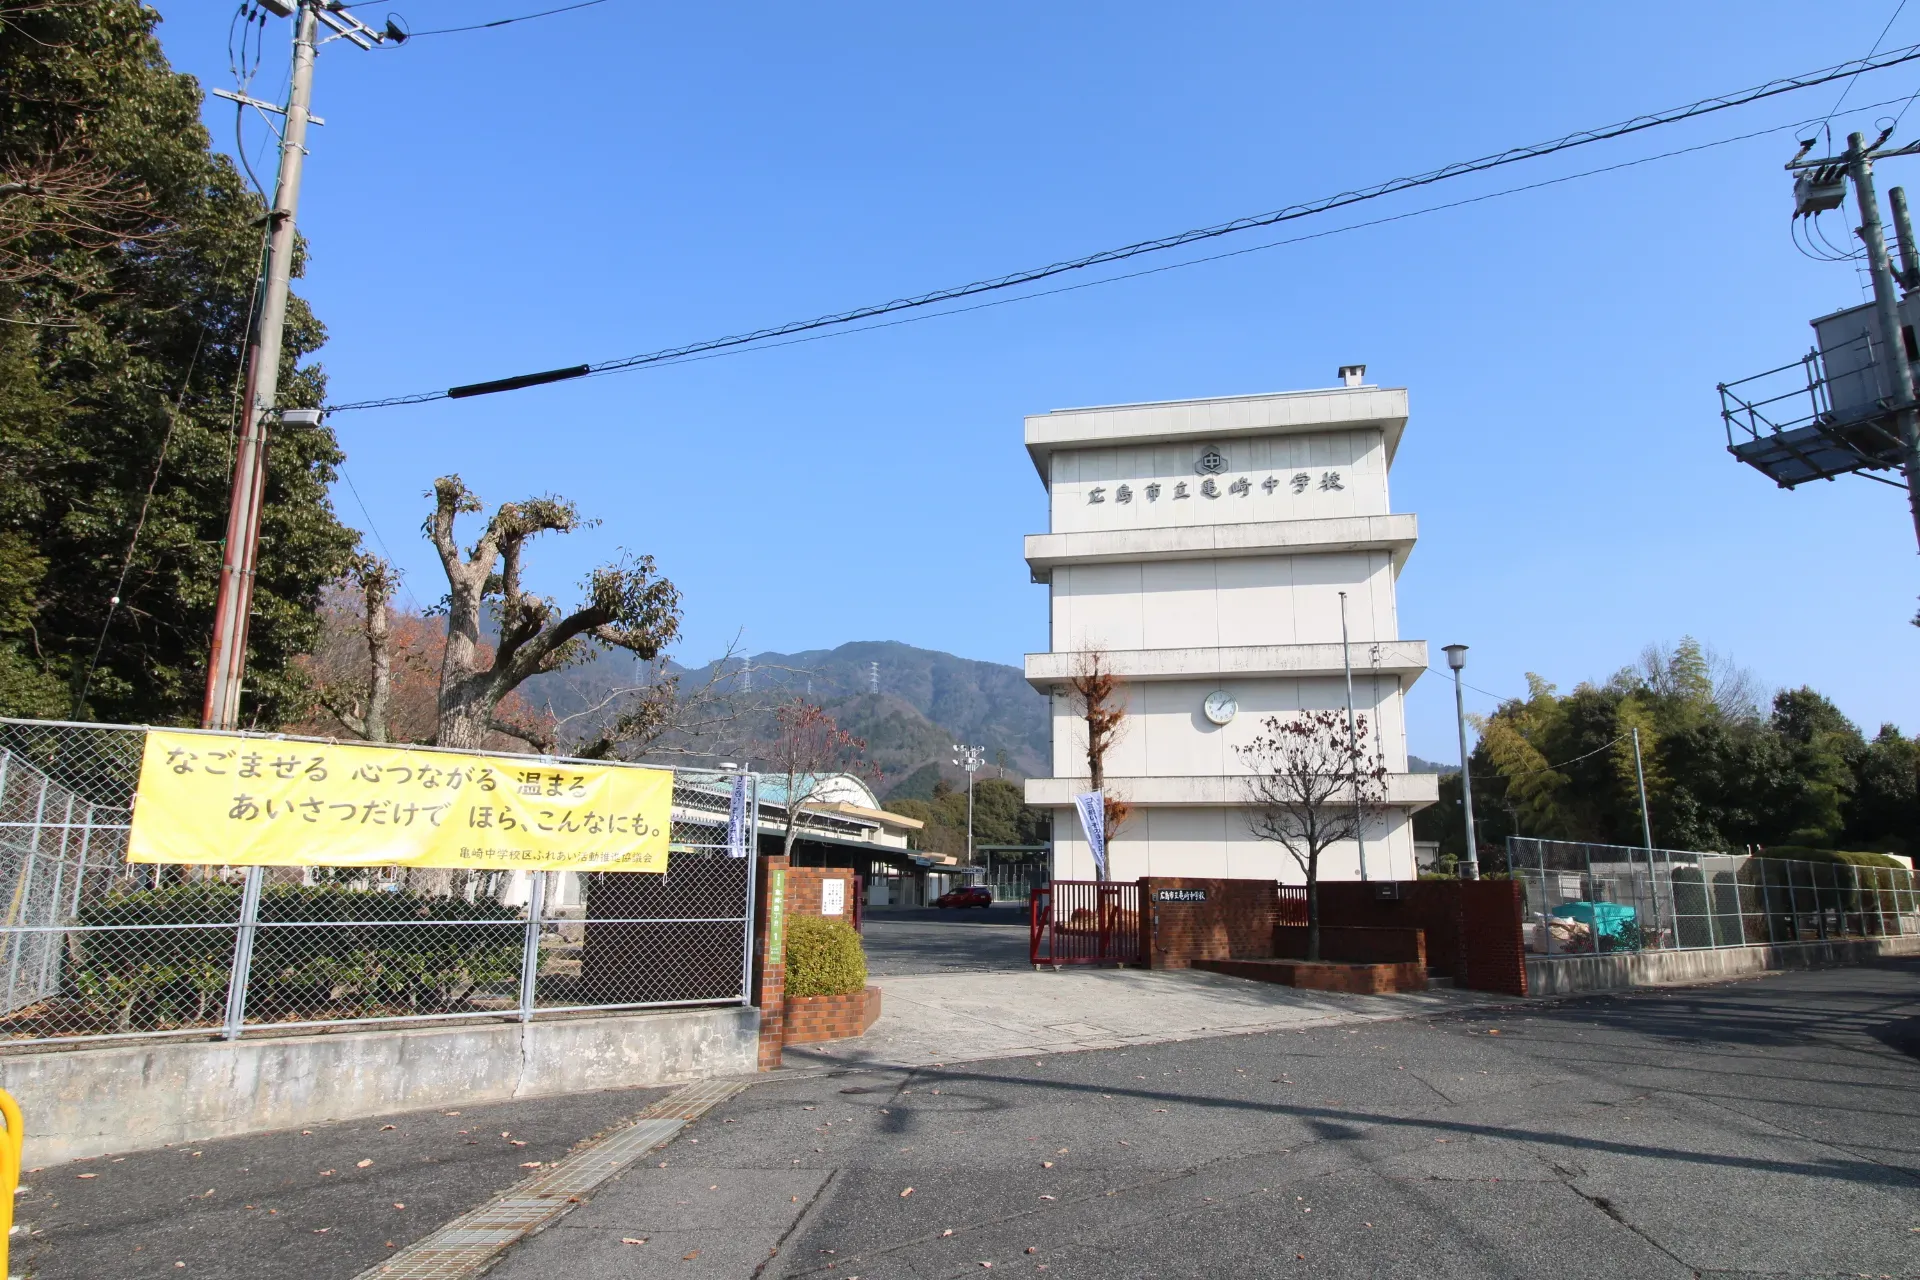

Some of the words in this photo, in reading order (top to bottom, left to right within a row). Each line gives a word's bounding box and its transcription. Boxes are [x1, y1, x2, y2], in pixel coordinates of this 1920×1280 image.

[1087, 471, 1344, 506] 広島市立亀崎中学校
[166, 747, 328, 782] なごませる
[351, 762, 498, 791] 心つながる
[516, 771, 587, 798] 温まる
[229, 793, 453, 828] あいさつだけで
[468, 805, 660, 838] ほら、こんなにも。
